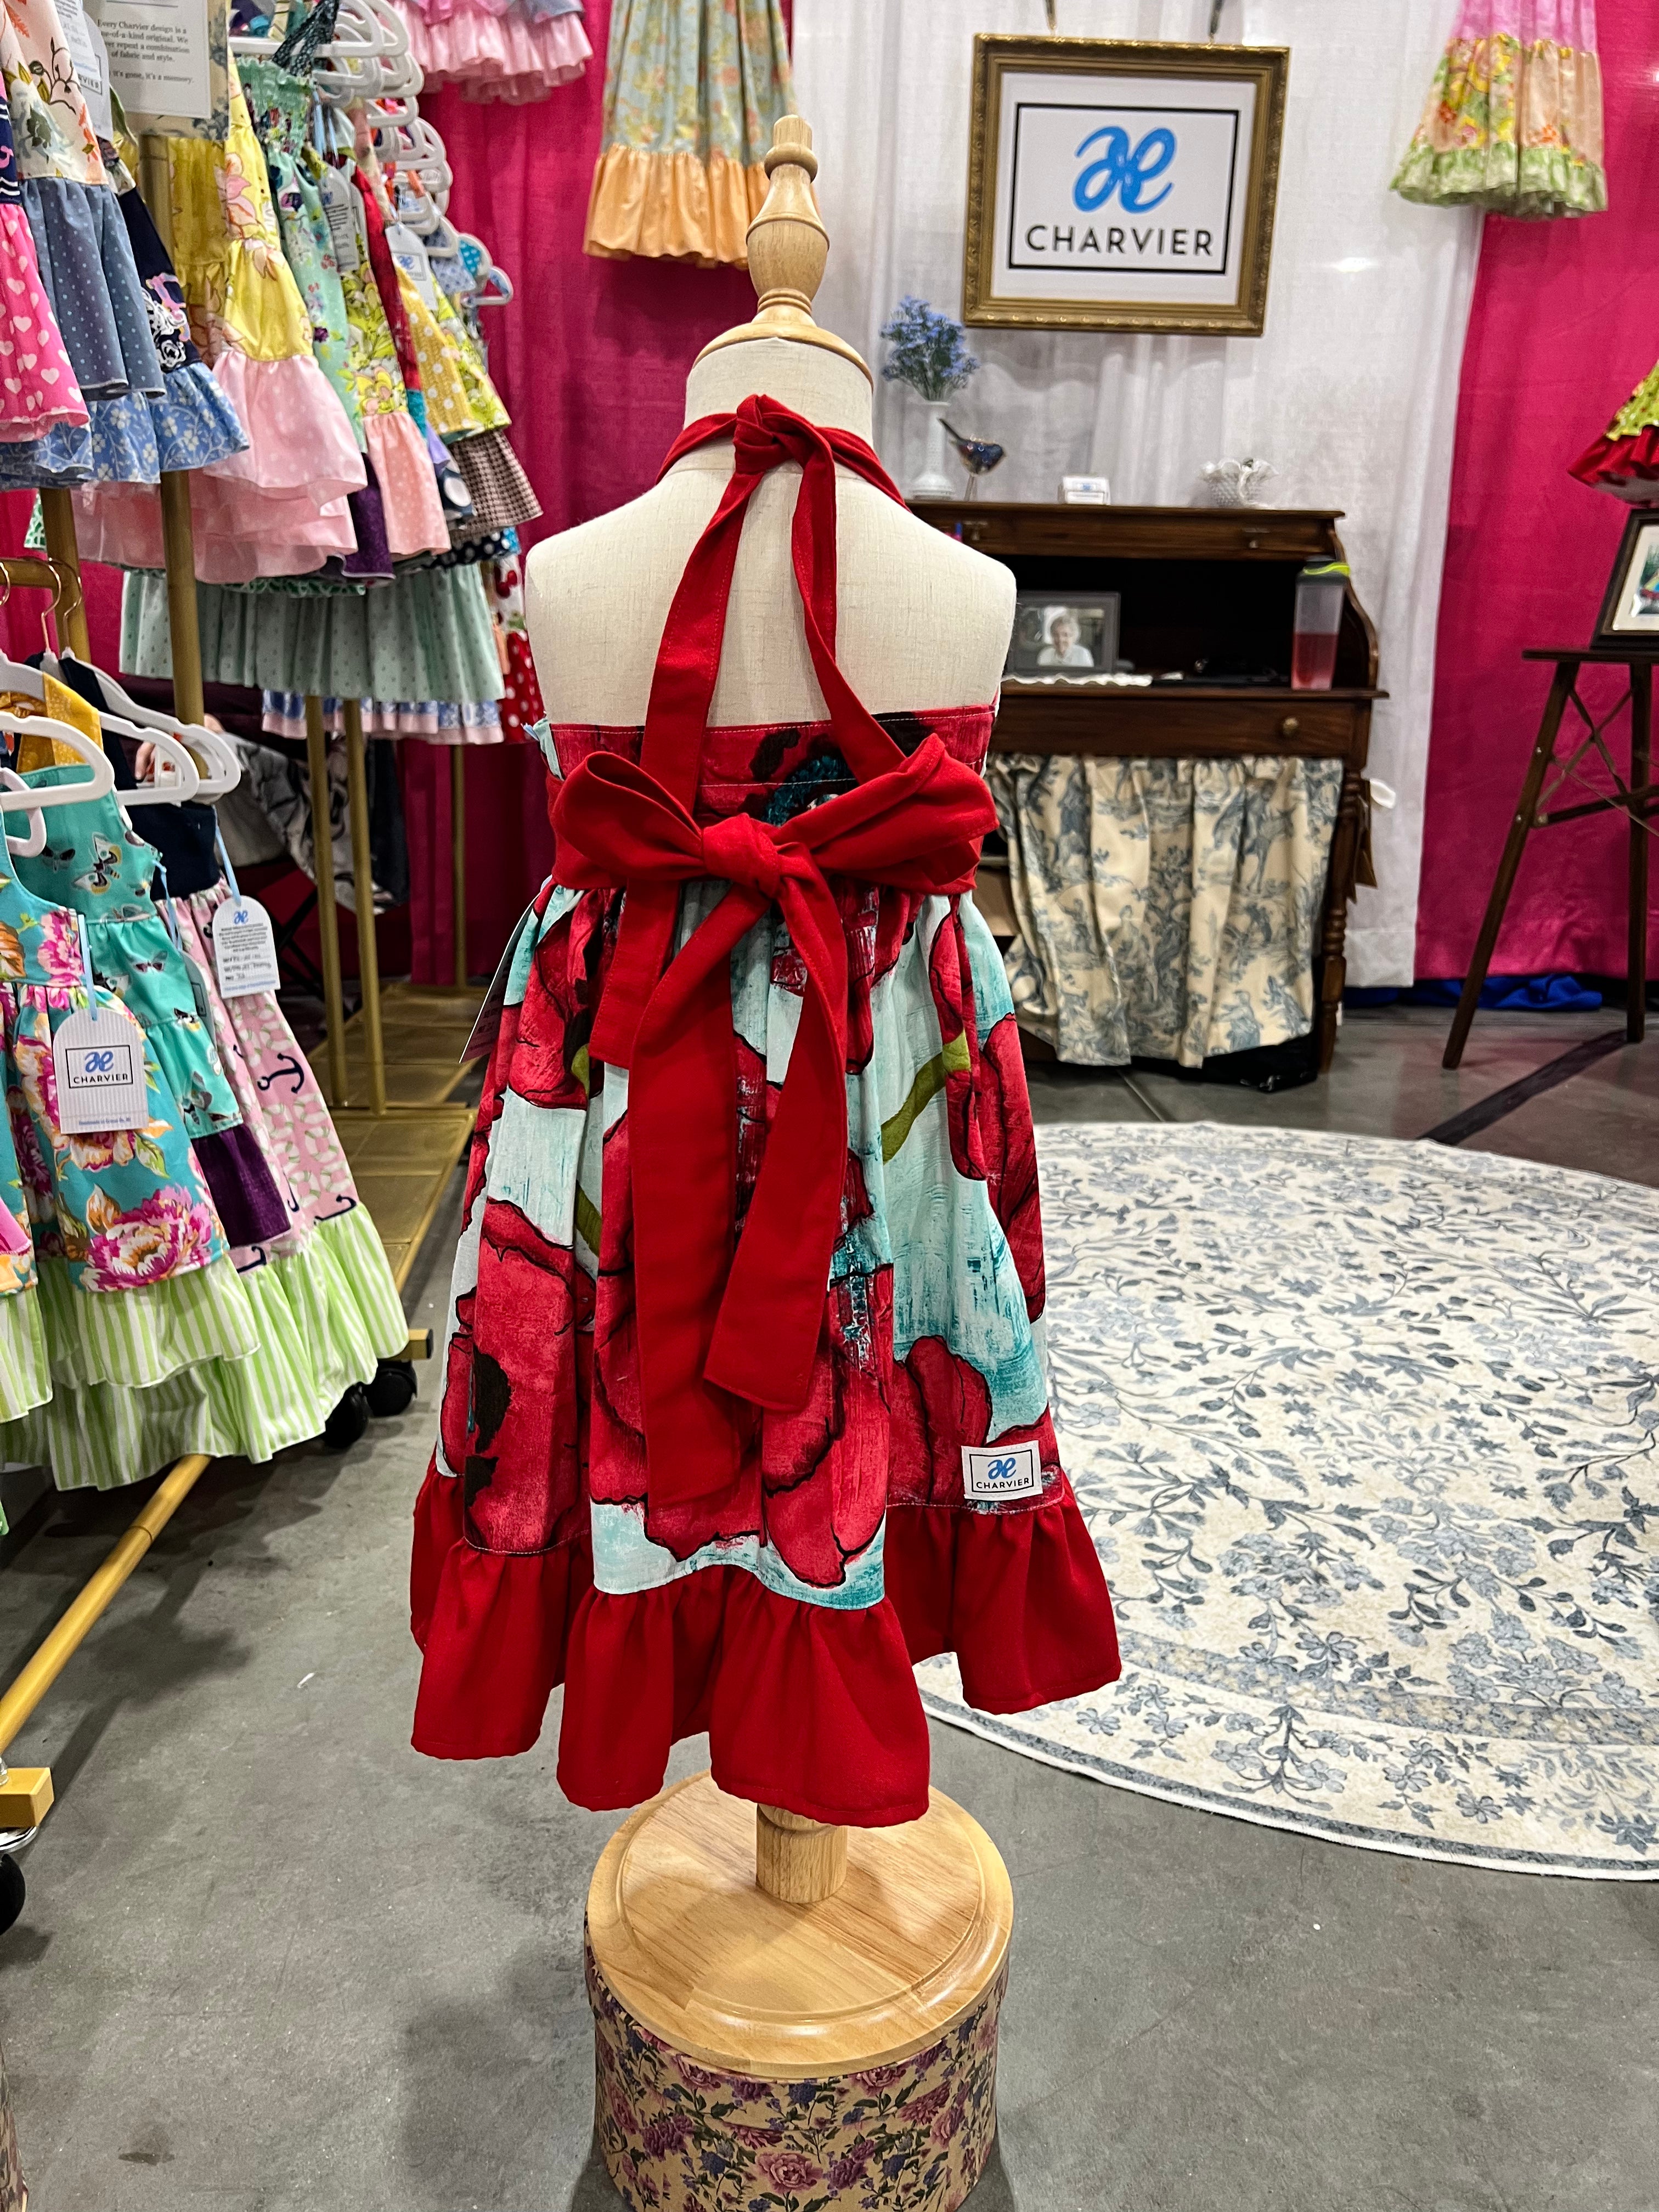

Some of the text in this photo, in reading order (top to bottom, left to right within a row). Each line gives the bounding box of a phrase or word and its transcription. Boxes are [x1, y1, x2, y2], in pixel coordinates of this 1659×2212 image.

[119, 20, 149, 30] Charvier
[150, 24, 173, 33] design
[101, 30, 144, 40] ne-of-a-kind
[146, 44, 190, 53] combination
[141, 52, 155, 60] and
[1025, 225, 1214, 257] CHARVIER
[74, 1073, 128, 1085] CHARVIER
[976, 1477, 1030, 1489] CHARVIER
